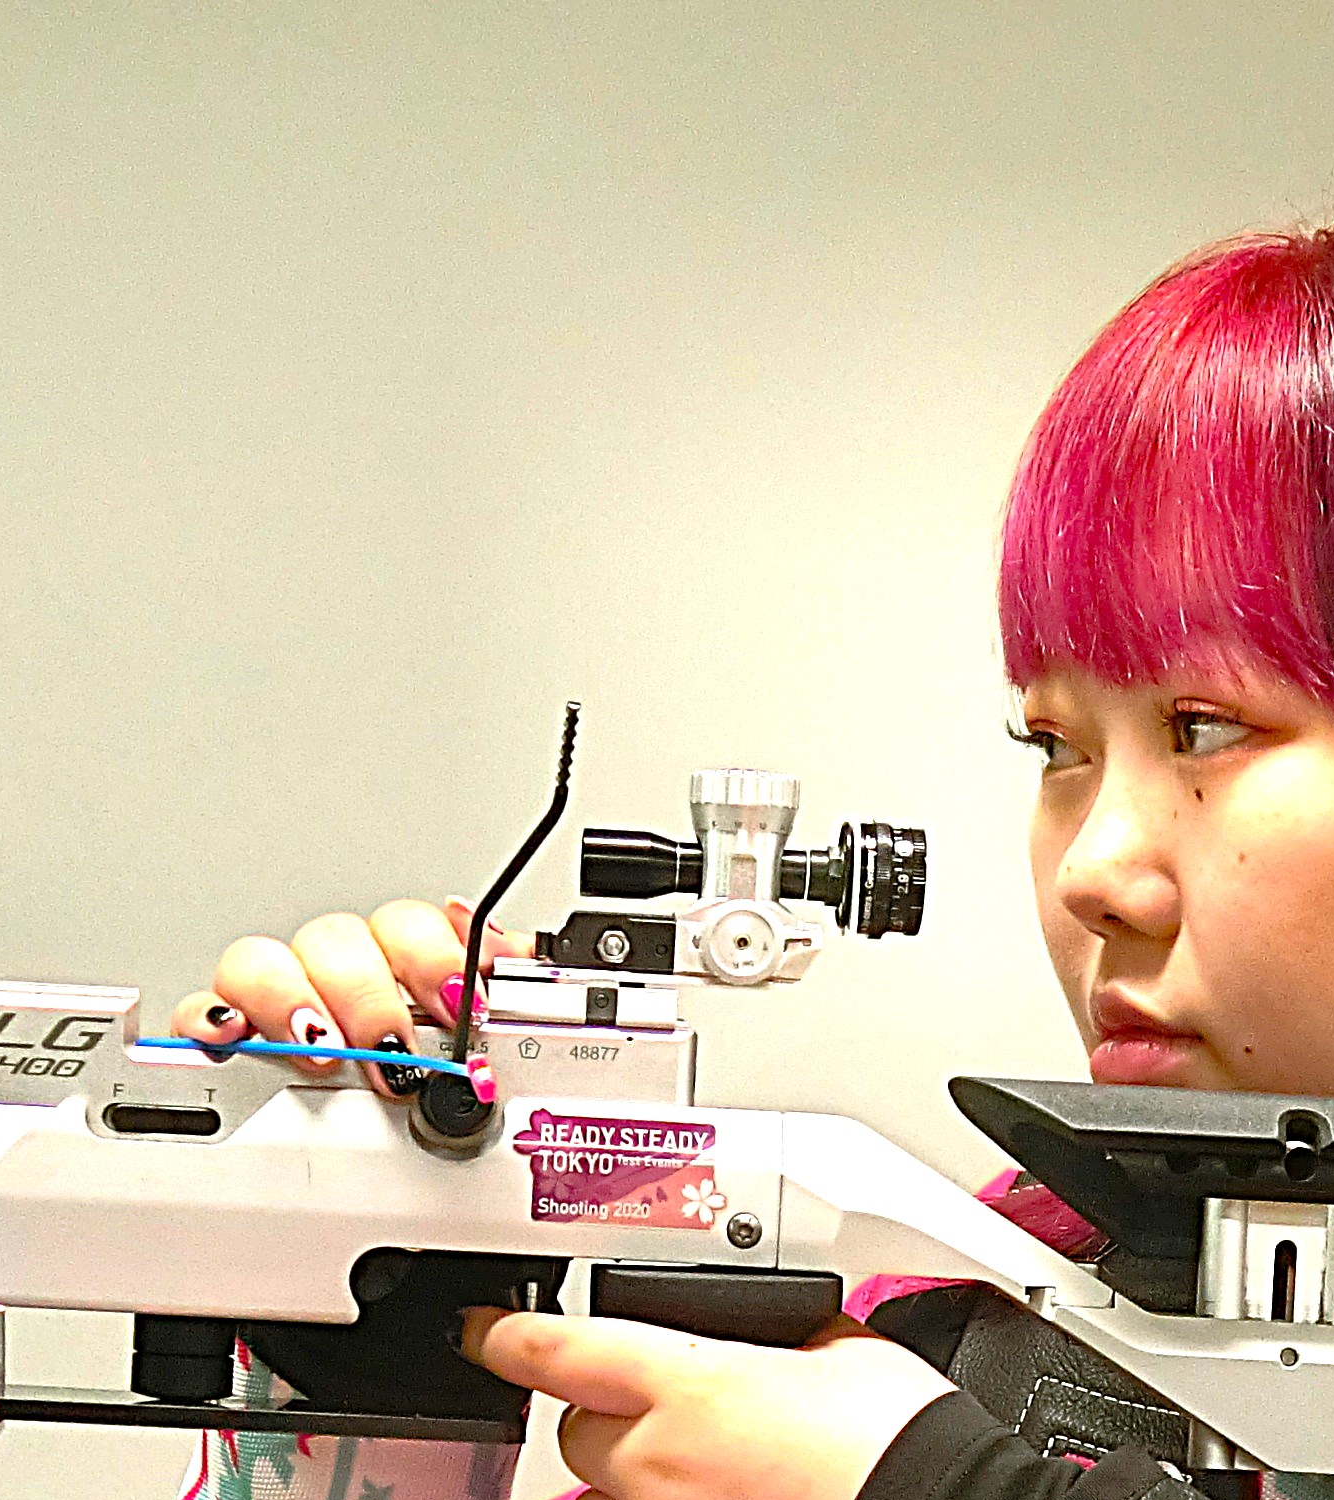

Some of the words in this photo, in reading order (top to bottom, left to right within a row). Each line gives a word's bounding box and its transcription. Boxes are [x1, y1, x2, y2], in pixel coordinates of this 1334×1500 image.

[569, 1045, 619, 1061] 48877
[112, 1083, 124, 1098] F
[204, 1088, 217, 1103] T
[540, 1123, 616, 1147] READY
[620, 1128, 708, 1150] STEADY
[538, 1150, 613, 1175] TOKYO
[537, 1198, 608, 1220] Shooting
[613, 1203, 650, 1219] 2020
